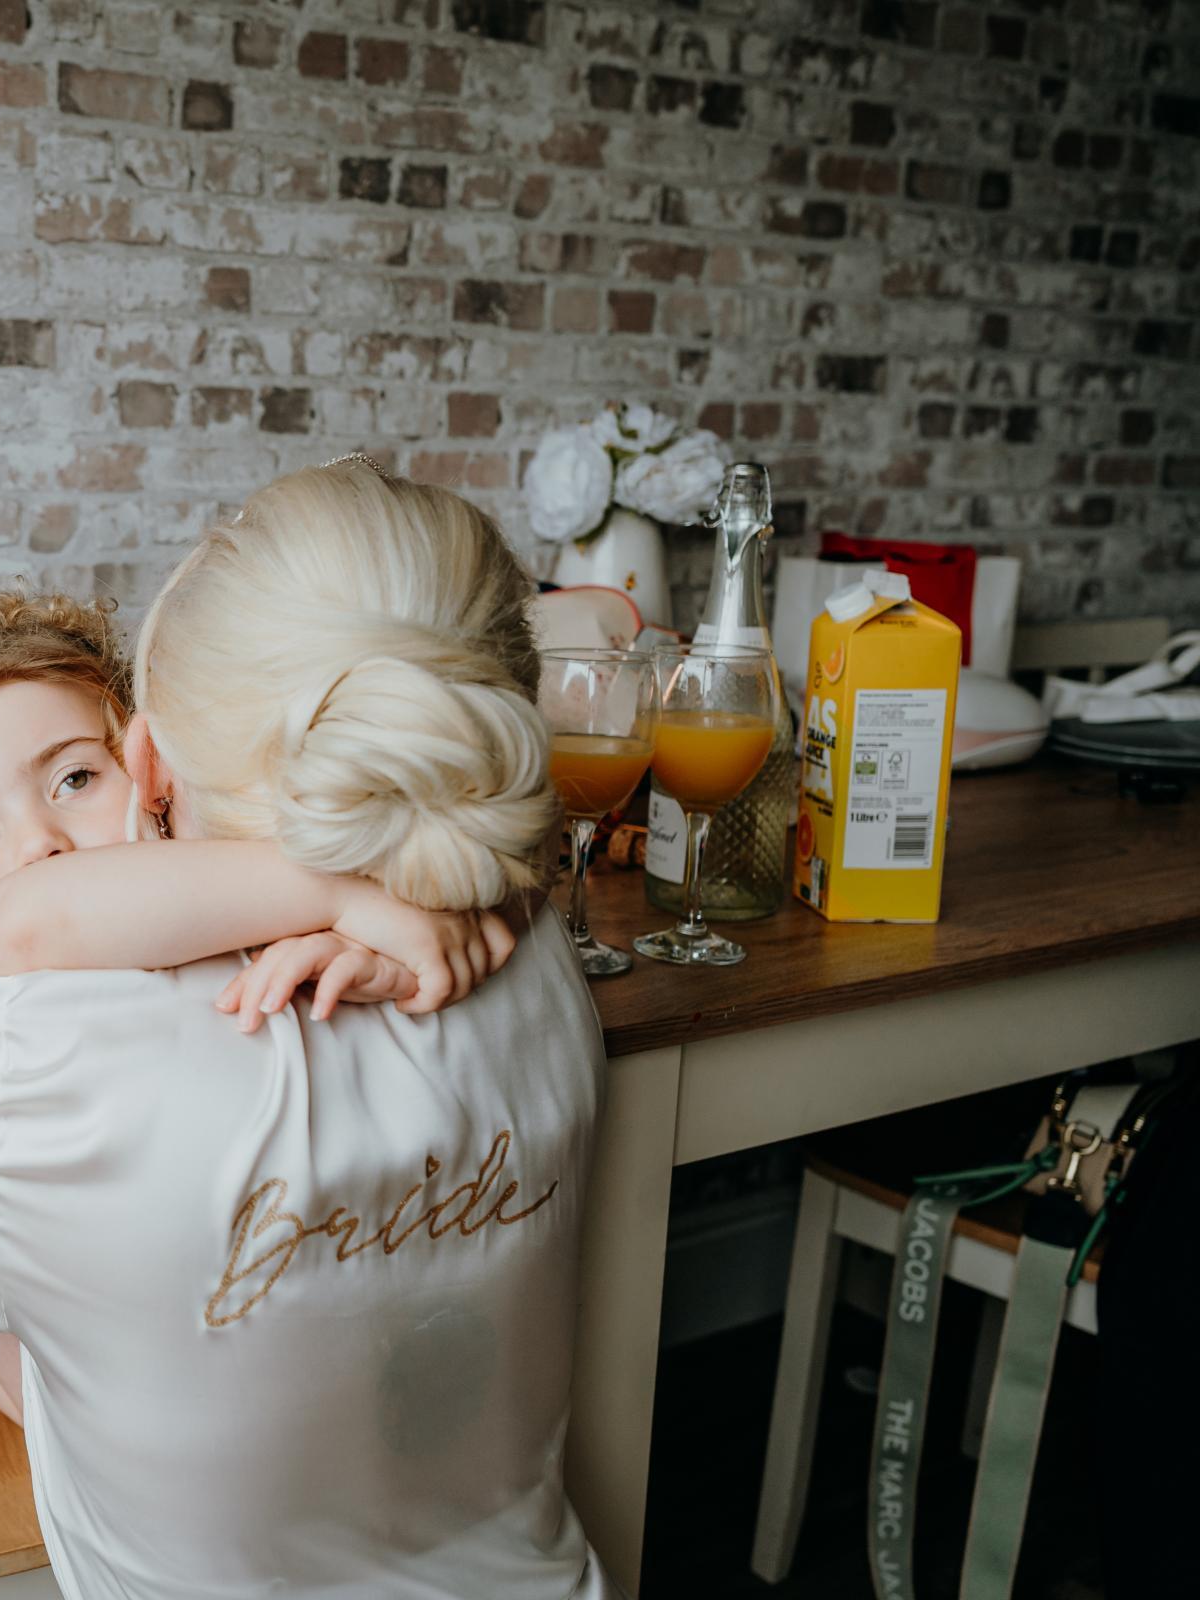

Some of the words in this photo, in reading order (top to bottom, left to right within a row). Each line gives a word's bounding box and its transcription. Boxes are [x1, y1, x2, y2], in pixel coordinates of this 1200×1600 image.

[850, 811, 855, 823] 1
[855, 811, 875, 823] Litre
[204, 1130, 559, 1328] Bride
[898, 1198, 940, 1323] JACOBS
[882, 1400, 914, 1455] THE
[877, 1458, 905, 1539] MARC
